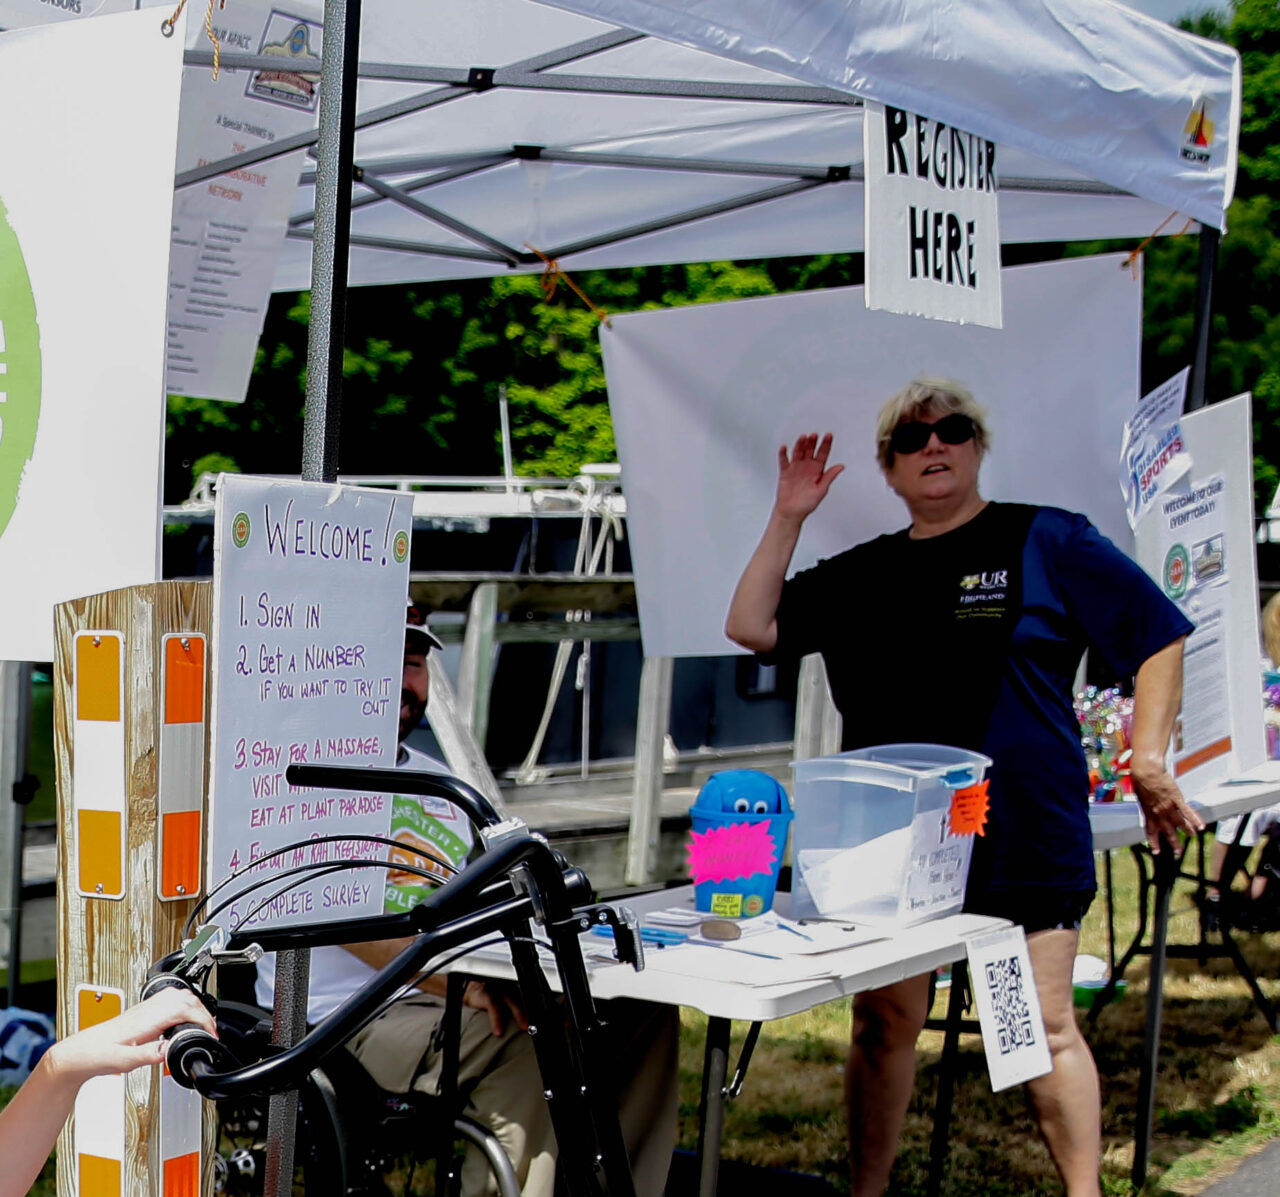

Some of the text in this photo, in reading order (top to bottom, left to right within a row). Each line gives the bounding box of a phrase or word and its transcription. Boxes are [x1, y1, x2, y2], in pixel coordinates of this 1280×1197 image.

[909, 206, 976, 289] HERE
[1140, 437, 1183, 491] SPORTS
[981, 569, 1008, 586] UR
[240, 595, 248, 627] 1.
[306, 602, 320, 629] IN
[236, 643, 366, 676] 2. Get A NUMBER
[261, 680, 272, 702] IF
[301, 679, 329, 699] WANT
[334, 679, 347, 695] TO
[353, 679, 373, 697] TRY
[378, 678, 391, 696] IT
[363, 699, 389, 717] OUT
[234, 737, 248, 770] 3.
[289, 743, 308, 765] FOR
[314, 739, 321, 759] A
[252, 773, 282, 798] VISIT
[250, 796, 383, 828] EAT AT PLANT PARADISE
[292, 848, 304, 867] AN
[246, 890, 313, 925] COMPLETE
[323, 881, 371, 909] SURVEY
